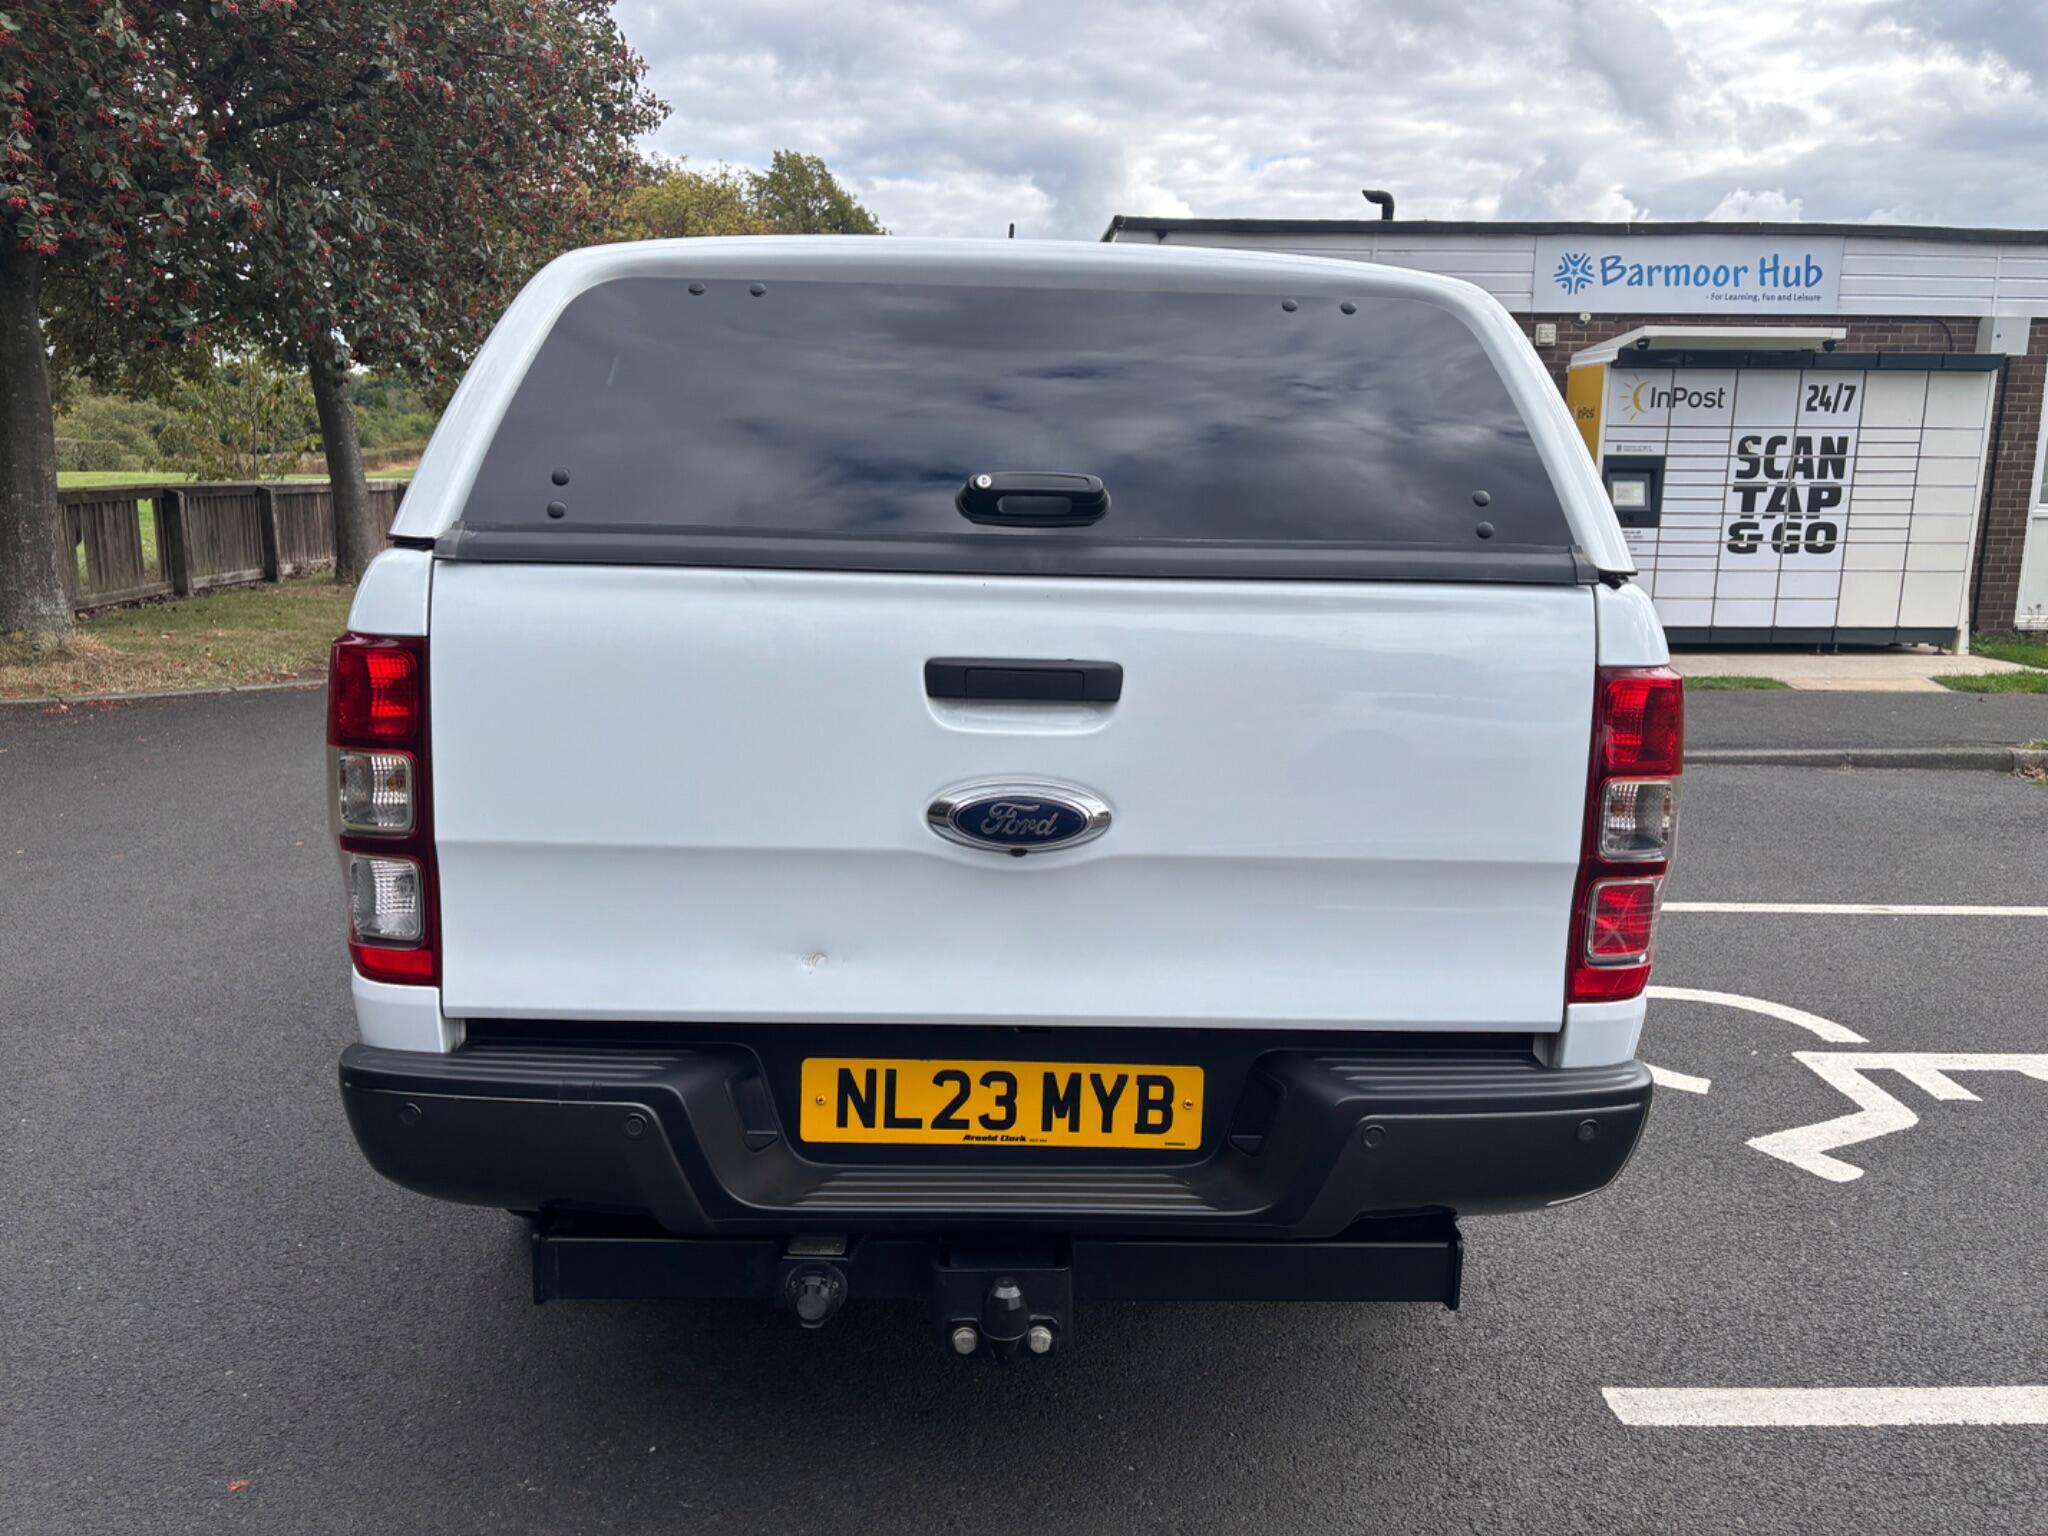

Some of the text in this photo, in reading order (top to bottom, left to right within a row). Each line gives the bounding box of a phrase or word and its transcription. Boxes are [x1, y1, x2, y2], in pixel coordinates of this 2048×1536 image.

[1600, 254, 1824, 288] Barmoor Hub
[1710, 292, 1723, 301] For
[1724, 292, 1760, 303] Learning,
[1777, 292, 1792, 301] and
[1793, 292, 1821, 302] Leisure
[1650, 386, 1726, 410] InPost
[1805, 382, 1857, 414] 24/7
[1735, 435, 1849, 480] SCAN
[1732, 481, 1843, 520] TAP
[1770, 521, 1838, 555] GO
[980, 802, 1059, 836] Ford
[835, 1067, 1175, 1135] NL23 MYB
[962, 1134, 998, 1142] Arnold
[1000, 1134, 1027, 1142] Clark
